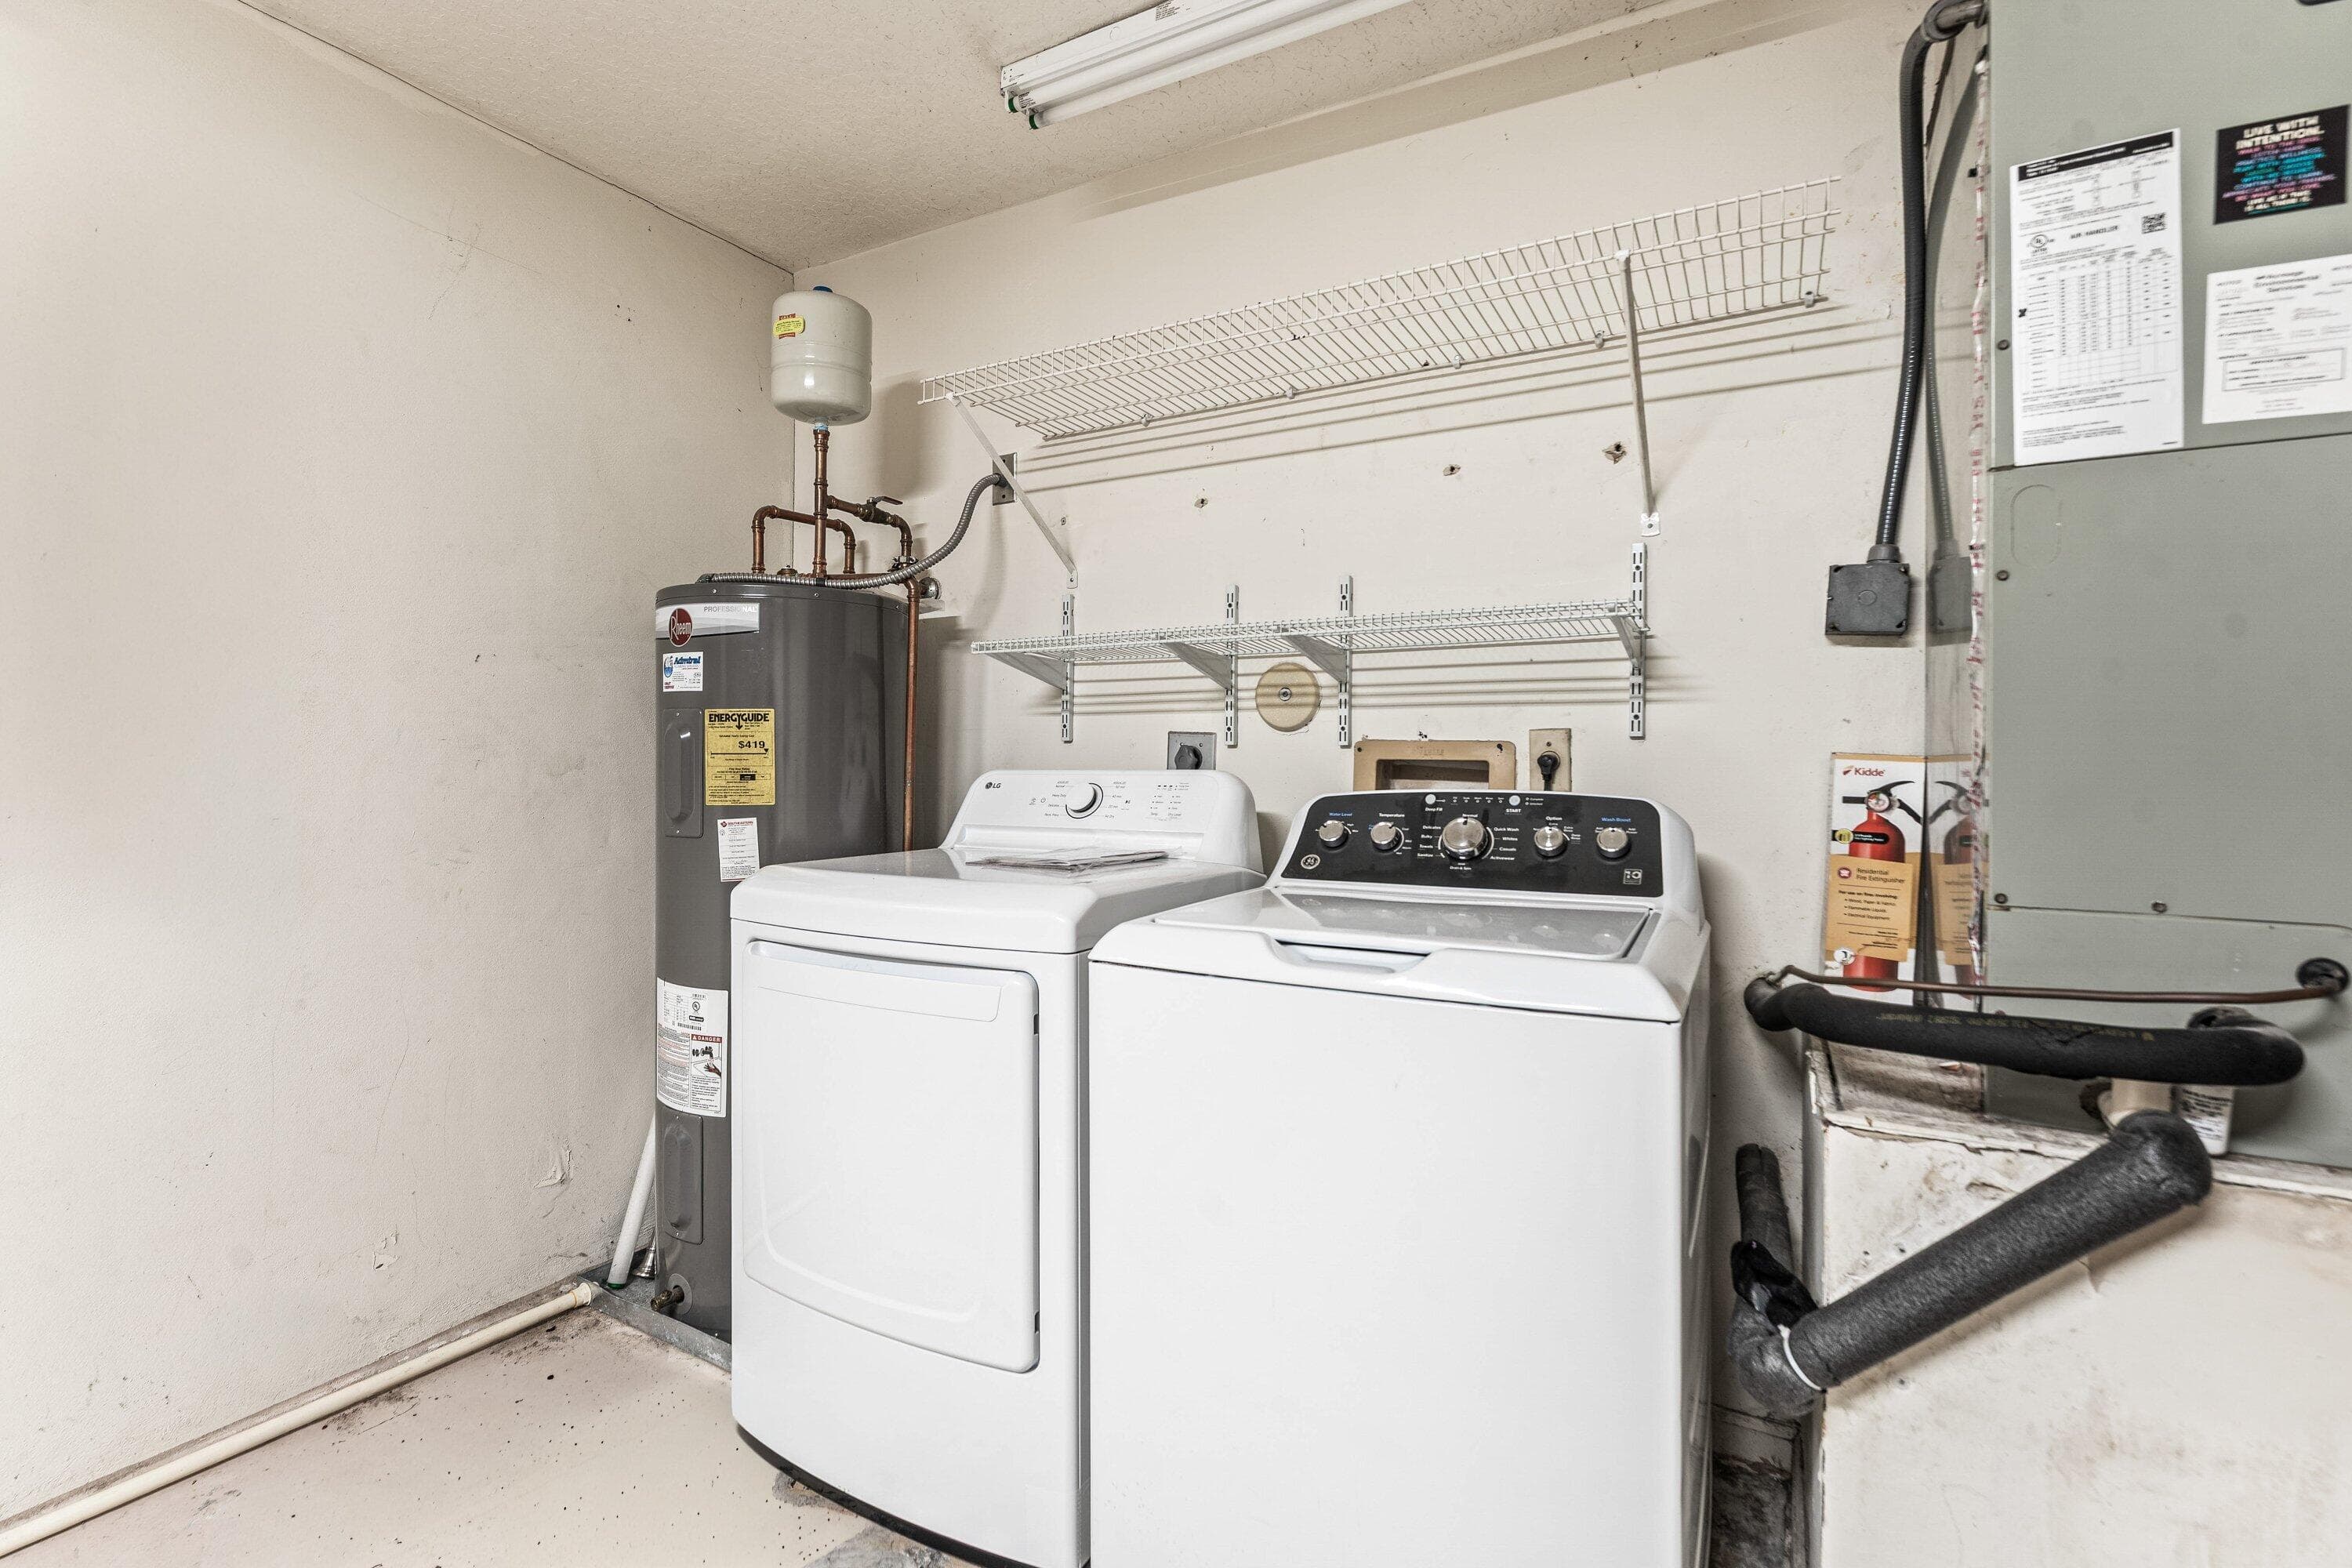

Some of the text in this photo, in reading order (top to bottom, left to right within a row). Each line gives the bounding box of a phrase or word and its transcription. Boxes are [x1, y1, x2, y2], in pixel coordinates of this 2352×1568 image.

[2276, 115, 2319, 132] WITH
[670, 609, 691, 640] Rheem
[673, 655, 701, 664] Admiral
[709, 713, 770, 724] ENERGYGUIDE
[738, 740, 765, 749] $419
[1854, 767, 1884, 777] Kidde
[1868, 875, 1905, 884] Extinguisher
